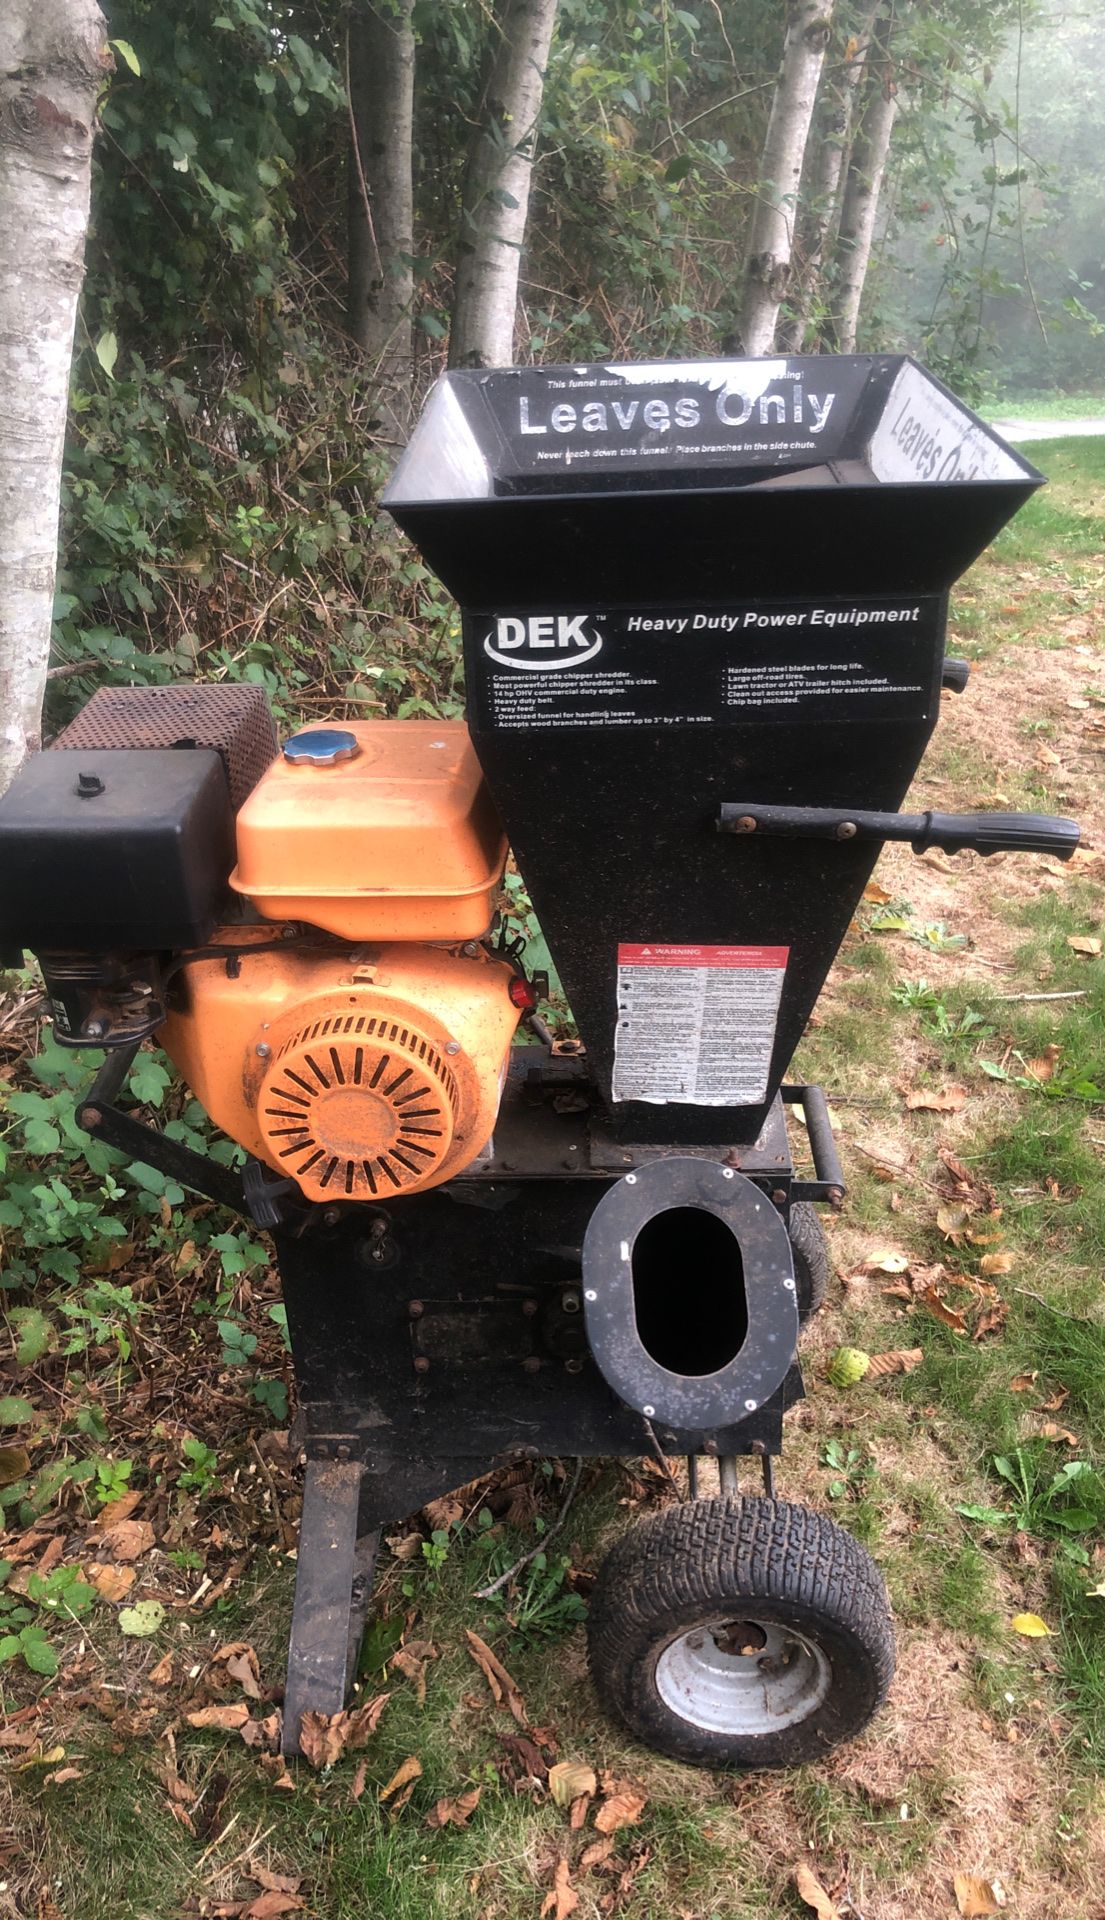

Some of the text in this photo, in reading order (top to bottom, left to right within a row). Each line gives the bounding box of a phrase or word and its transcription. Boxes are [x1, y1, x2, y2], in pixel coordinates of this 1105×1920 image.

[548, 380, 566, 388] This
[569, 378, 597, 388] funnel
[600, 378, 622, 386] must
[520, 384, 835, 434] Leaves Only
[891, 397, 942, 479] Leaves
[537, 451, 562, 460] Never
[593, 448, 617, 457] down
[620, 448, 637, 456] this
[675, 445, 700, 453] Place
[701, 443, 742, 452] branches
[754, 442, 767, 450] the
[769, 441, 788, 449] side
[627, 607, 920, 633] Heavy Duty Power Equipment
[498, 616, 590, 649] DEK
[580, 688, 597, 696] duty
[795, 687, 830, 696] provided
[494, 698, 518, 706] Heavy
[655, 948, 702, 956] WARNING
